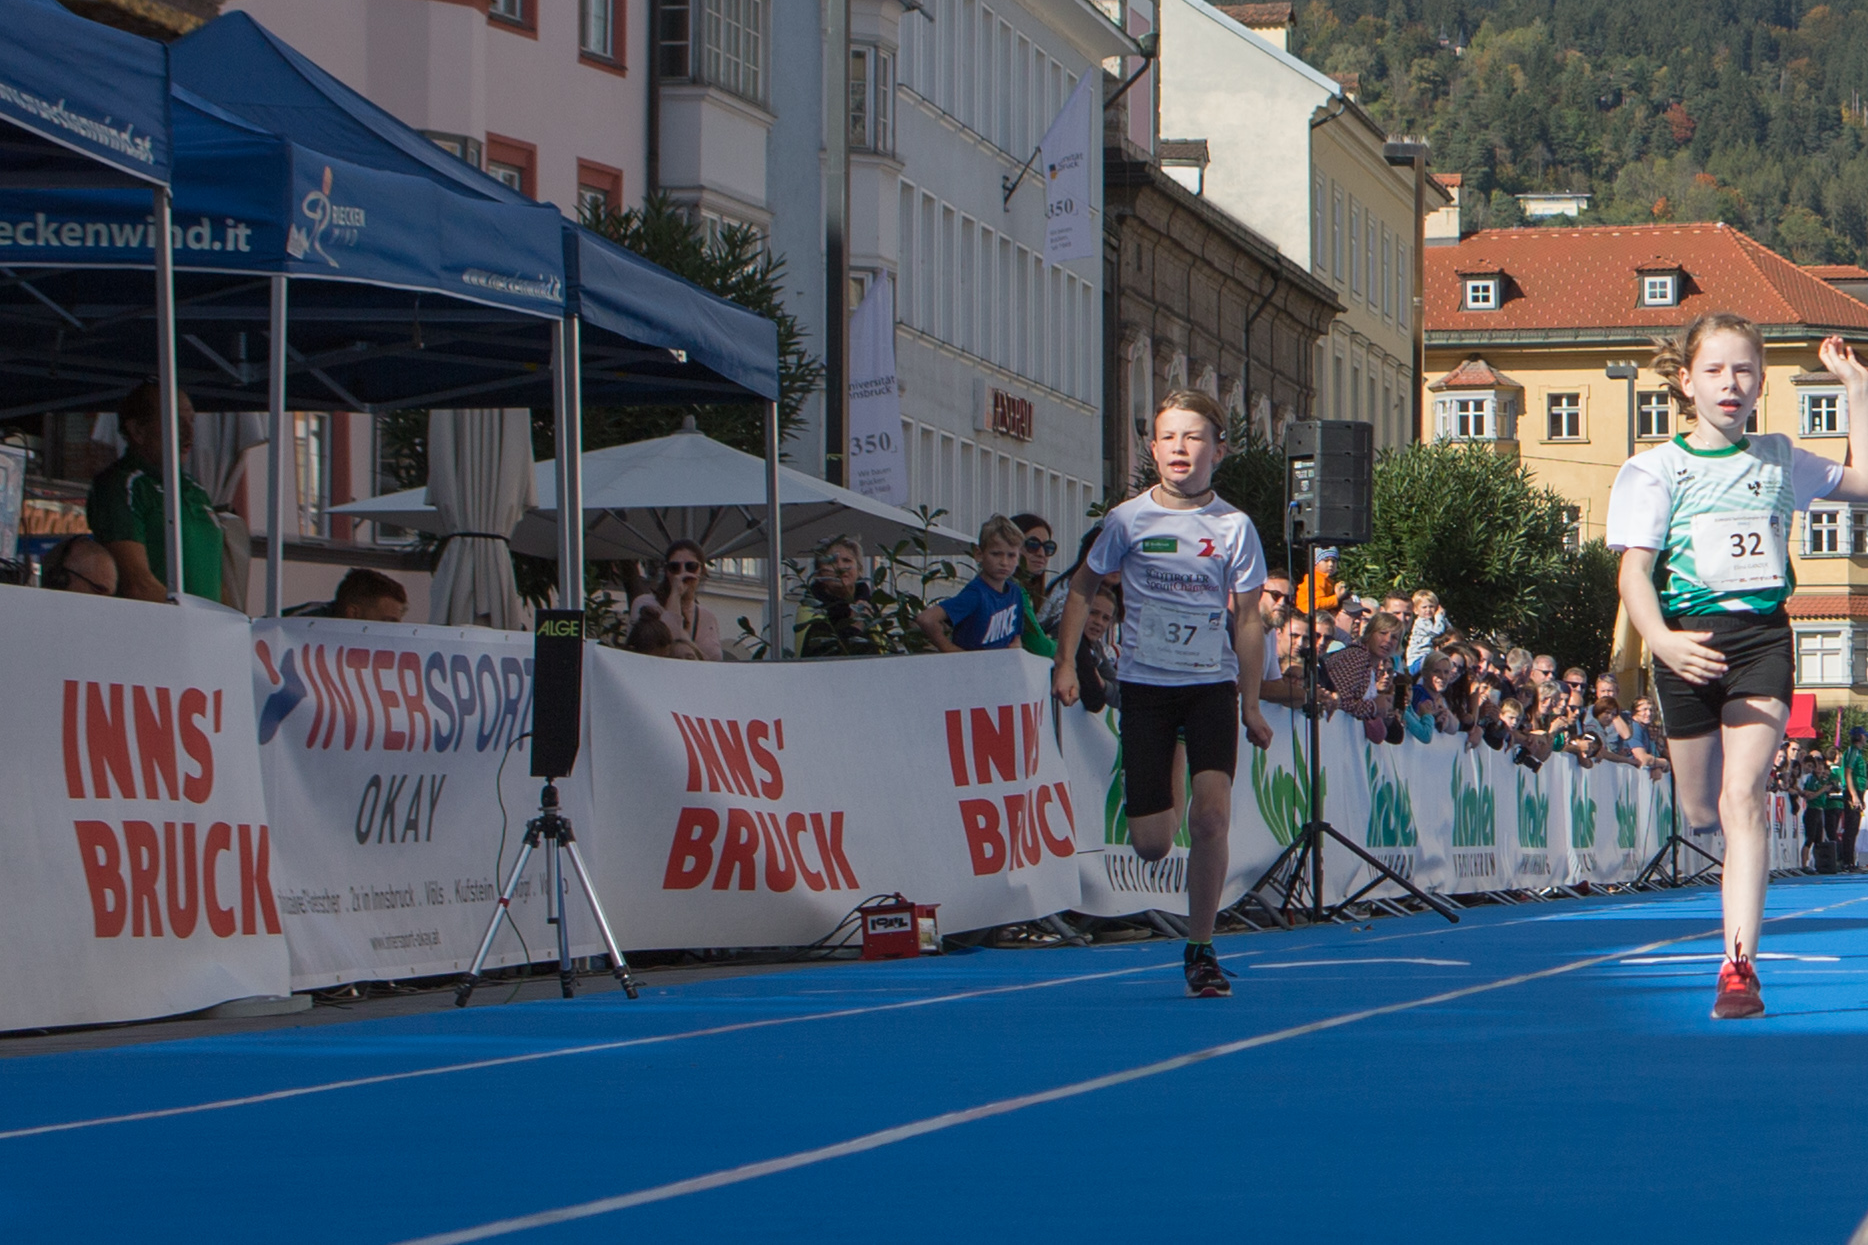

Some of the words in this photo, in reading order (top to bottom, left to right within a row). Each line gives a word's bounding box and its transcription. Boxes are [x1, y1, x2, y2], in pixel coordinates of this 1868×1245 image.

[849, 375, 896, 390] niversität
[850, 432, 892, 456] 350
[1730, 532, 1765, 557] 32
[536, 620, 580, 637] ALGE
[981, 603, 1019, 644] NIKE
[1165, 622, 1198, 646] 37
[62, 679, 223, 804] INNS'
[670, 710, 785, 802] INNS'
[355, 773, 447, 845] OKAY
[662, 806, 861, 894] BRUCK
[73, 819, 283, 939] BRUCK
[425, 880, 445, 906] Völs
[455, 877, 495, 904] Kufstein
